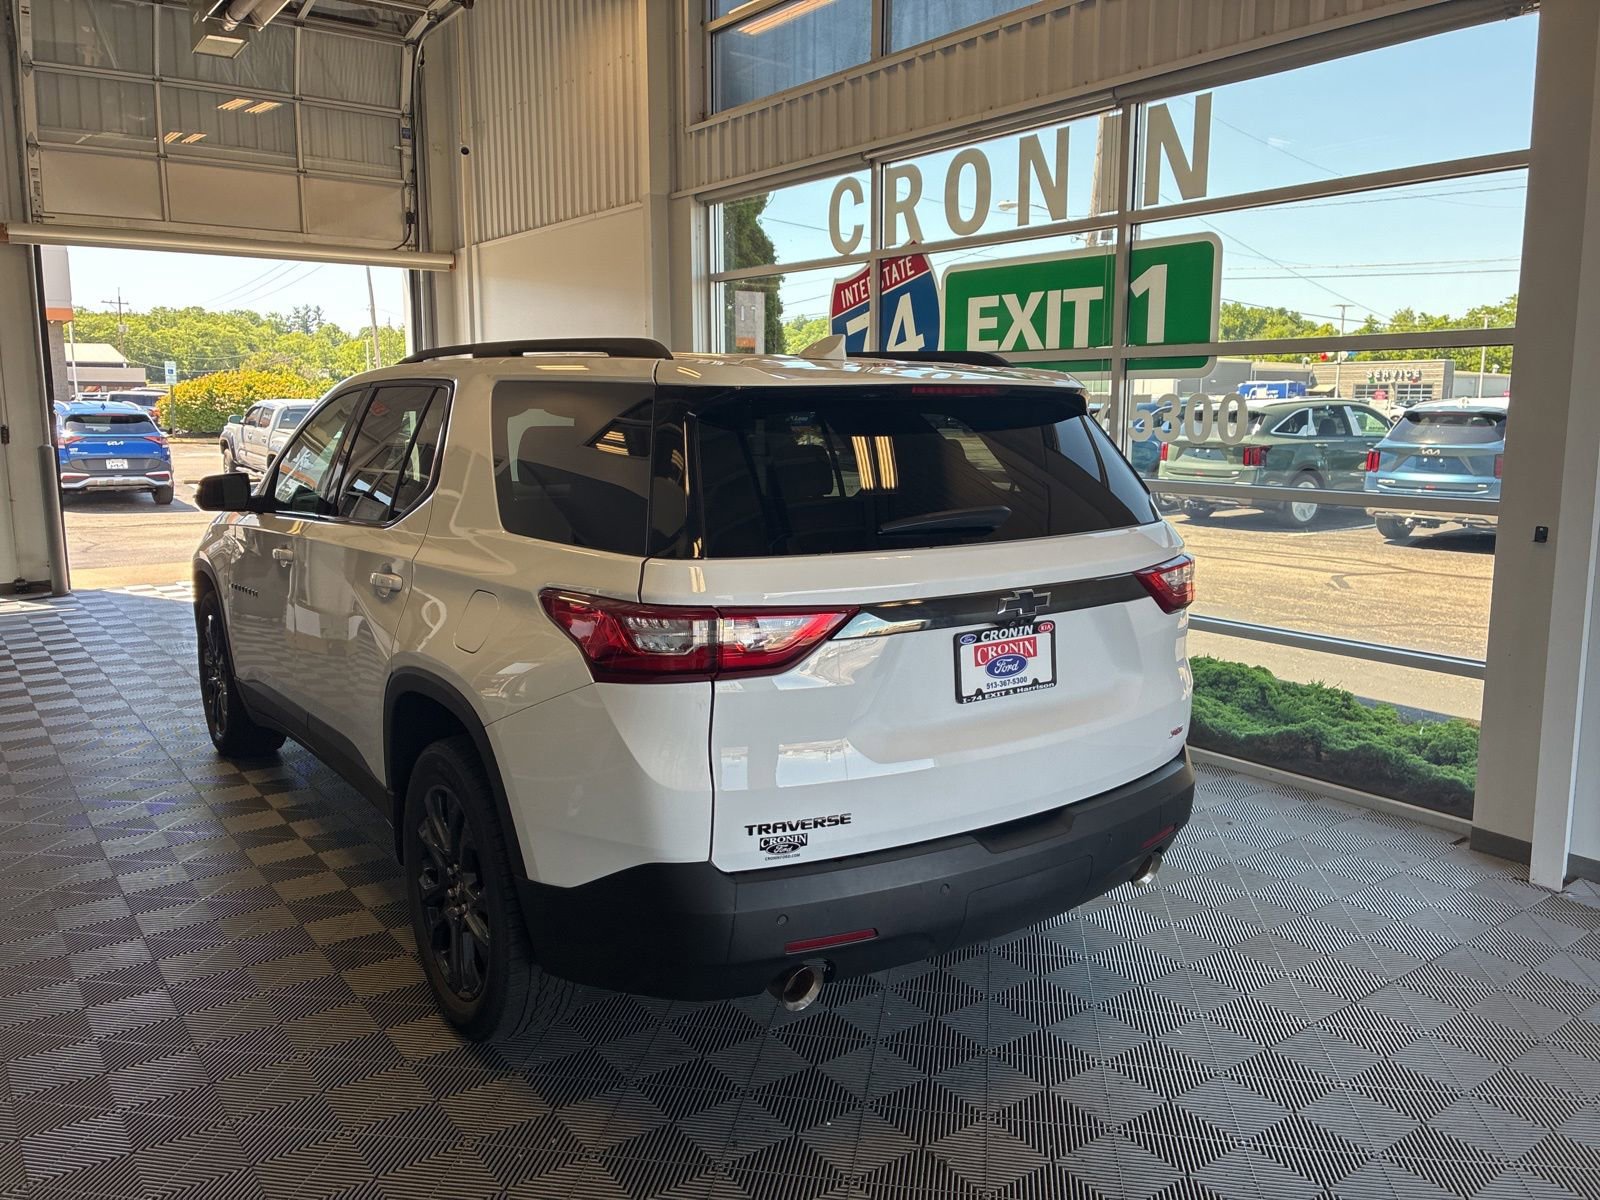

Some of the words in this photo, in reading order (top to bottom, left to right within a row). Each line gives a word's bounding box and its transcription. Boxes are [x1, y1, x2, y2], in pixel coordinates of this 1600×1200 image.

[829, 92, 1212, 255] CRONIN
[841, 256, 915, 309] INTETATE
[967, 286, 1104, 352] EXIT
[1130, 264, 1167, 344] 1
[1366, 367, 1421, 379] SERVICE
[981, 625, 1034, 642] CRONIN
[1039, 624, 1053, 632] KIA
[977, 640, 1035, 665] CRONIN
[994, 658, 1020, 674] Ford
[985, 690, 1007, 699] EXIT
[1008, 687, 1015, 696] 1
[1016, 682, 1055, 692] Harrison
[986, 676, 1028, 688] 513-367-5300
[744, 812, 852, 836] TRAVERSE
[760, 834, 808, 848] CRONIN
[772, 844, 794, 853] Ford
